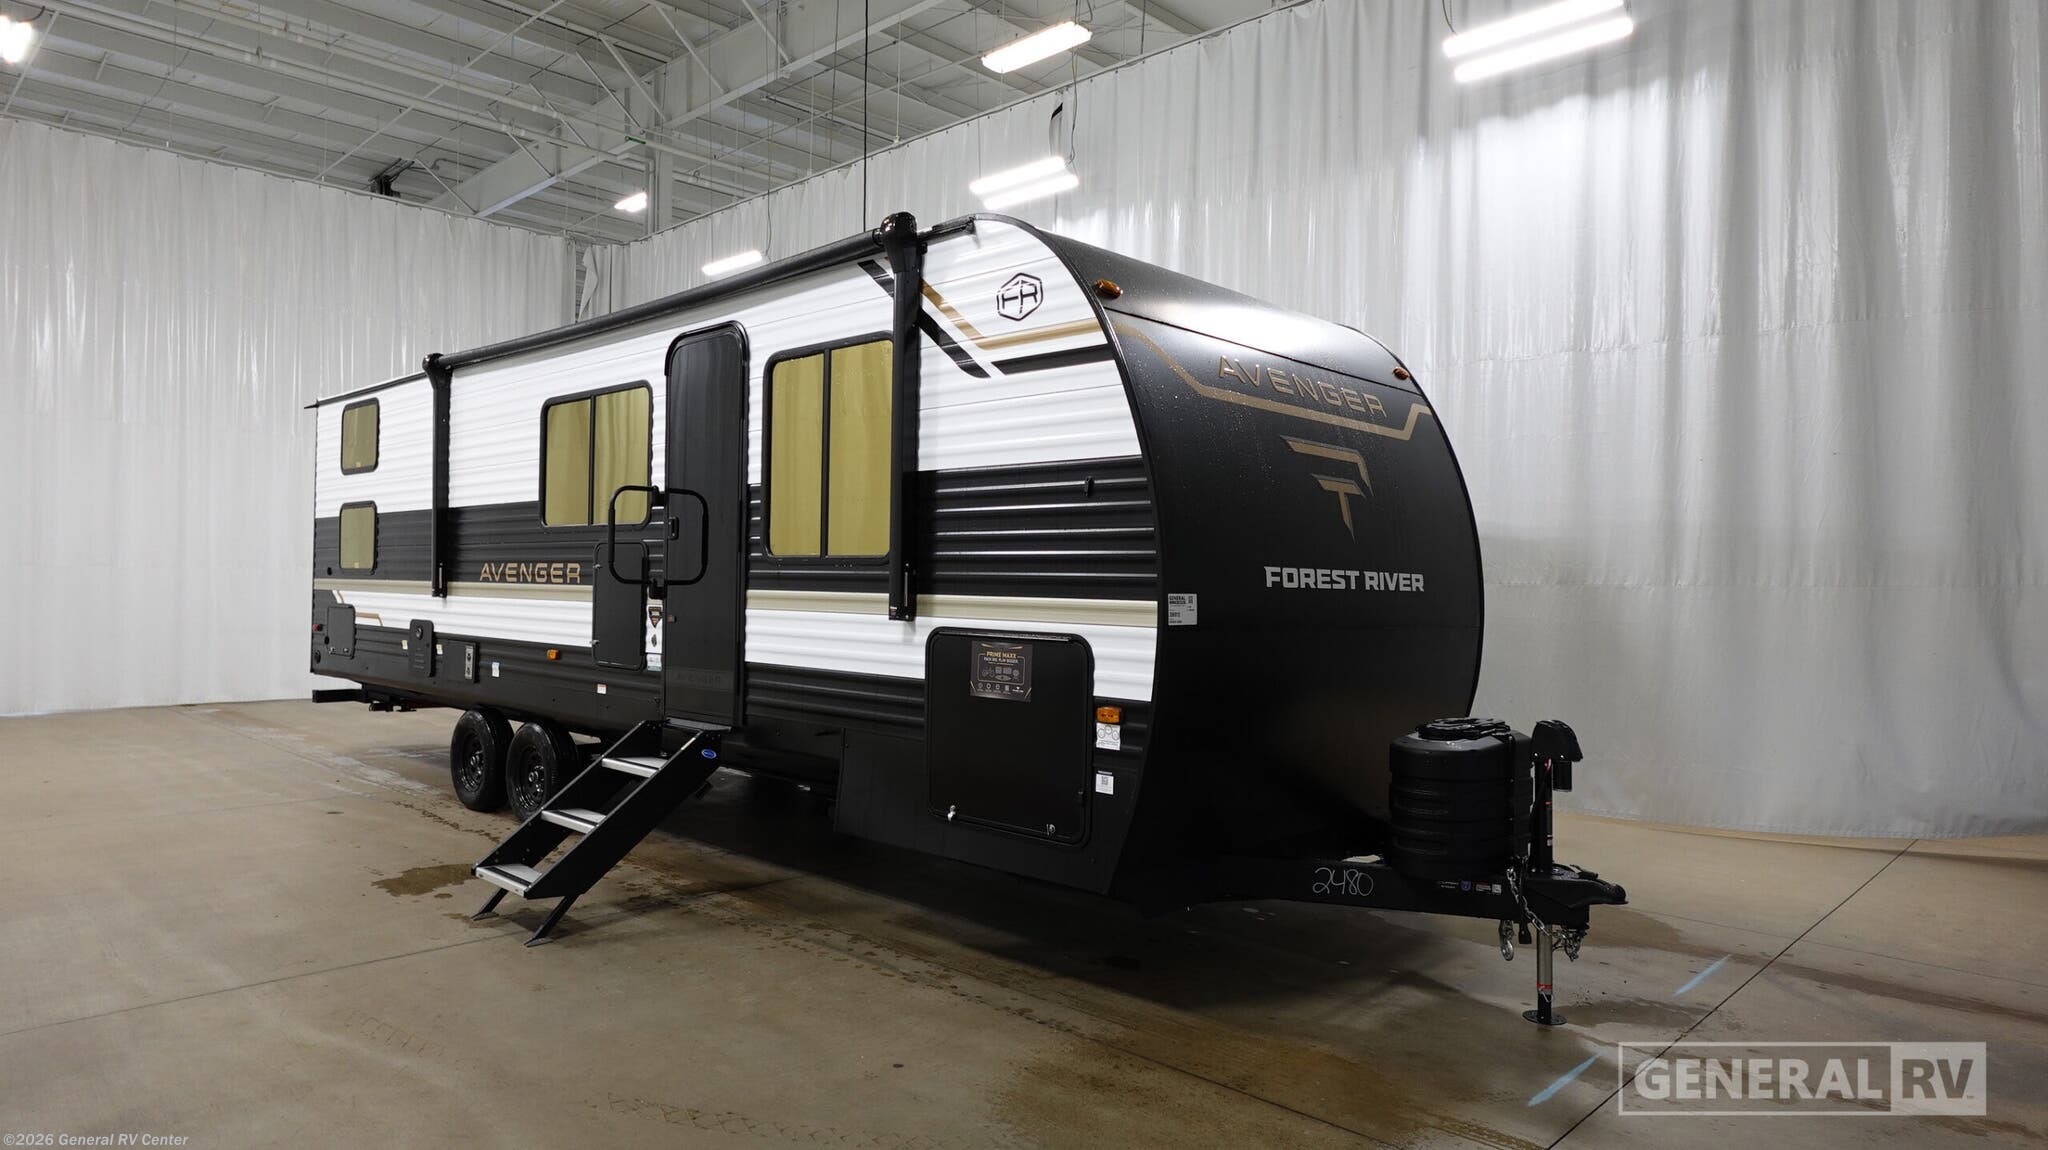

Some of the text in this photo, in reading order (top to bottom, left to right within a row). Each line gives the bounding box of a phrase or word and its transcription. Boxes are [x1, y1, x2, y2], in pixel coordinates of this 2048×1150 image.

[1218, 355, 1387, 417] AVENGER
[479, 562, 581, 584] AVENGER
[1264, 566, 1425, 592] FOREST RIVER
[1312, 867, 1374, 897] 2480
